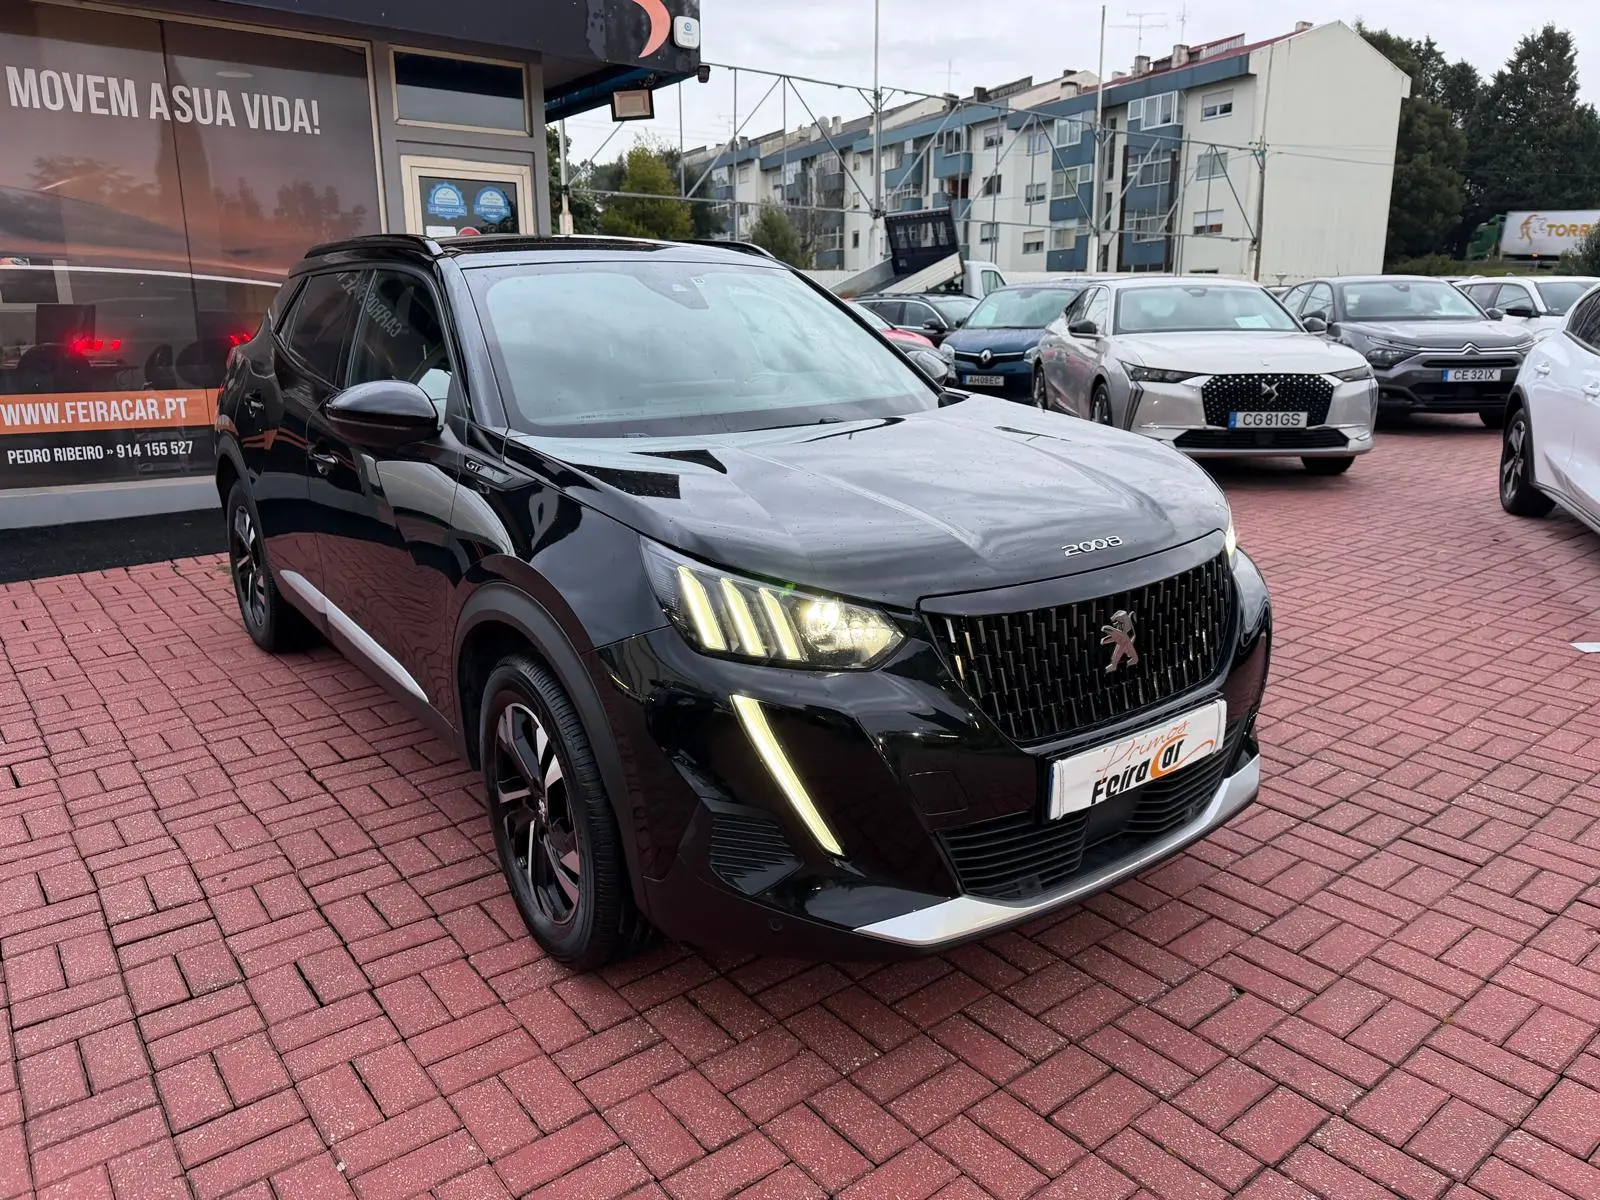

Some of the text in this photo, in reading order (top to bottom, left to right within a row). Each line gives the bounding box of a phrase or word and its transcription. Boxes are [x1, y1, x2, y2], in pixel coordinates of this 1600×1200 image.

[5, 66, 320, 135] MOVEM A SUA VIDA!
[0, 397, 187, 427] WWW.FEIRACAR.PT
[7, 448, 50, 465] PEDRO
[54, 445, 104, 463] RIBEIRO
[117, 441, 141, 458] 914
[145, 441, 168, 457] 155
[170, 440, 193, 455] 527
[466, 460, 483, 472] GT
[1061, 535, 1123, 557] 2008
